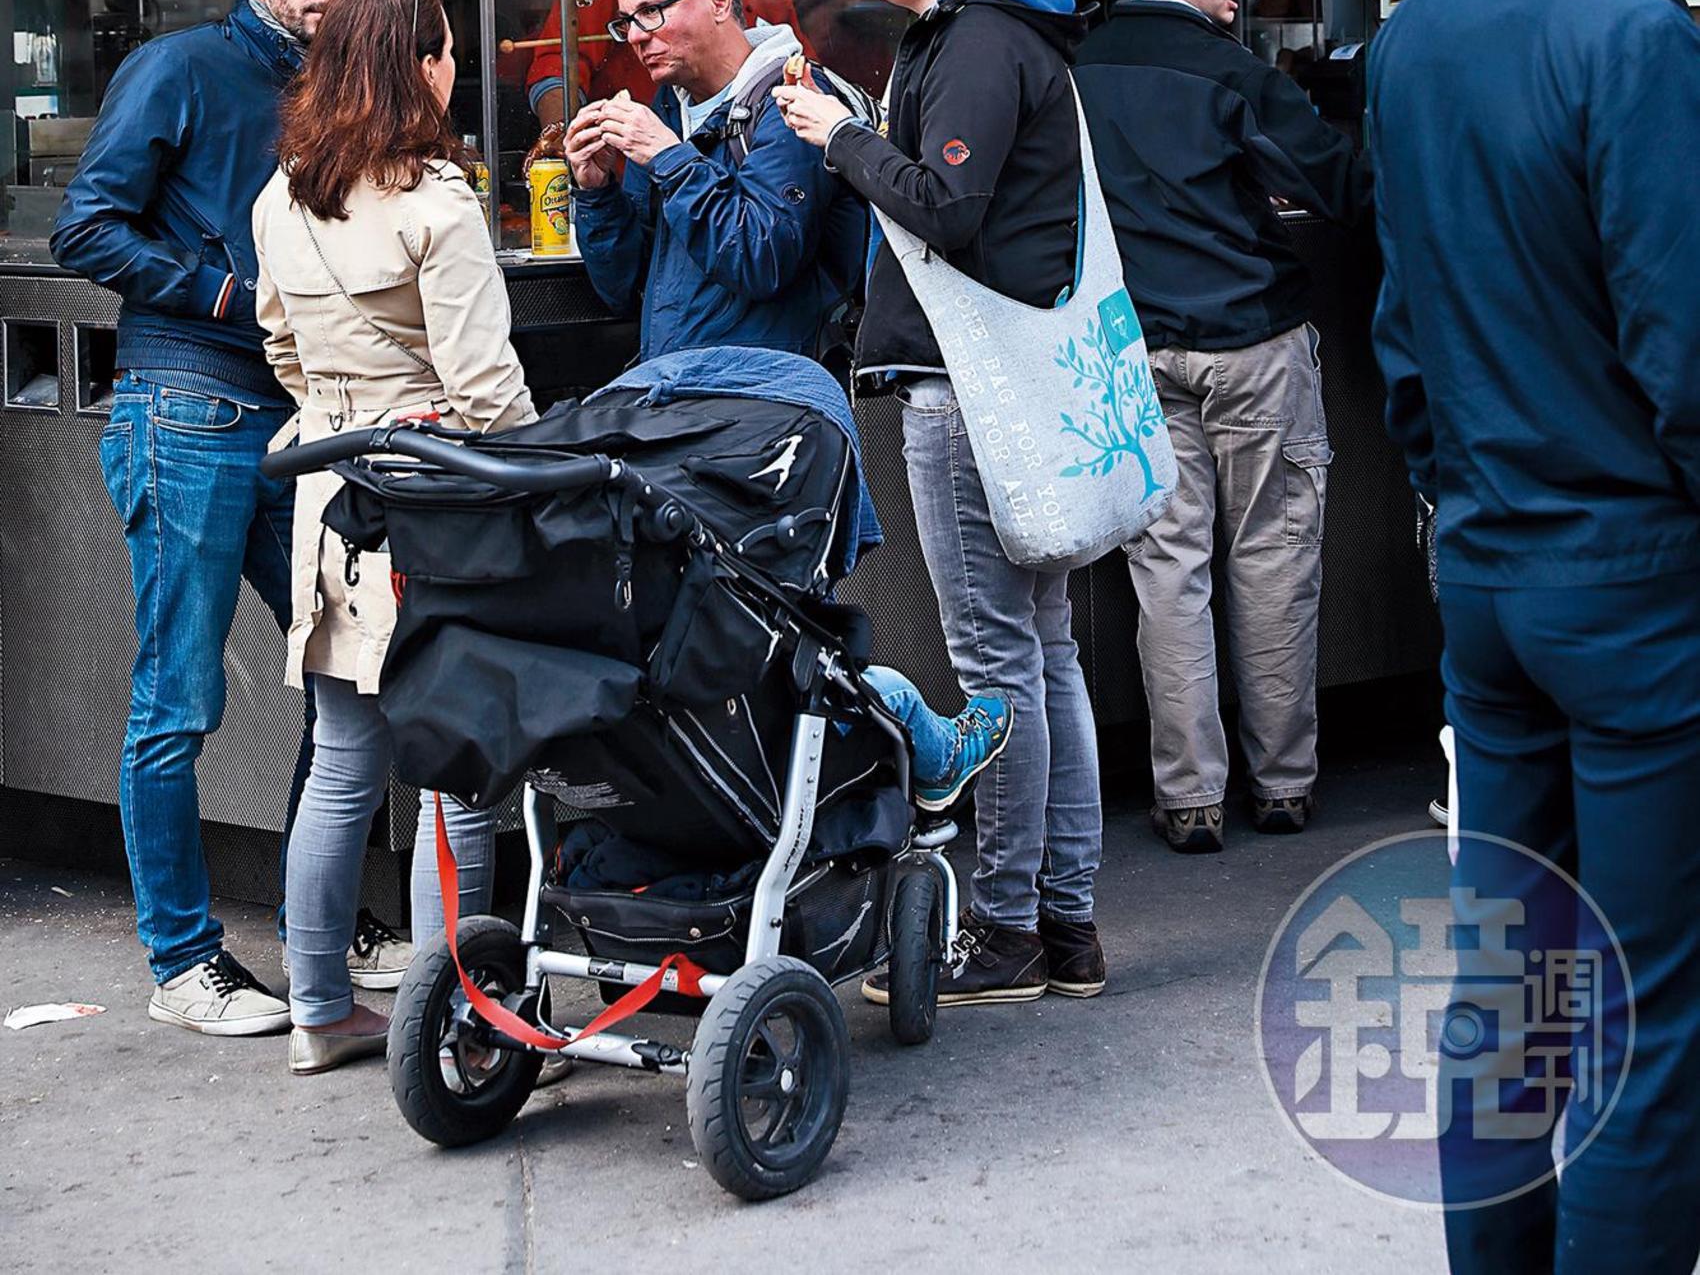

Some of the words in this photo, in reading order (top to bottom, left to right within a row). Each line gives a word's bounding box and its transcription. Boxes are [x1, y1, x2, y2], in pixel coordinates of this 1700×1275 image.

[944, 334, 984, 398] TREE
[978, 410, 1010, 463] FOR
[955, 294, 989, 342] ONE
[1010, 418, 1042, 470] FOR
